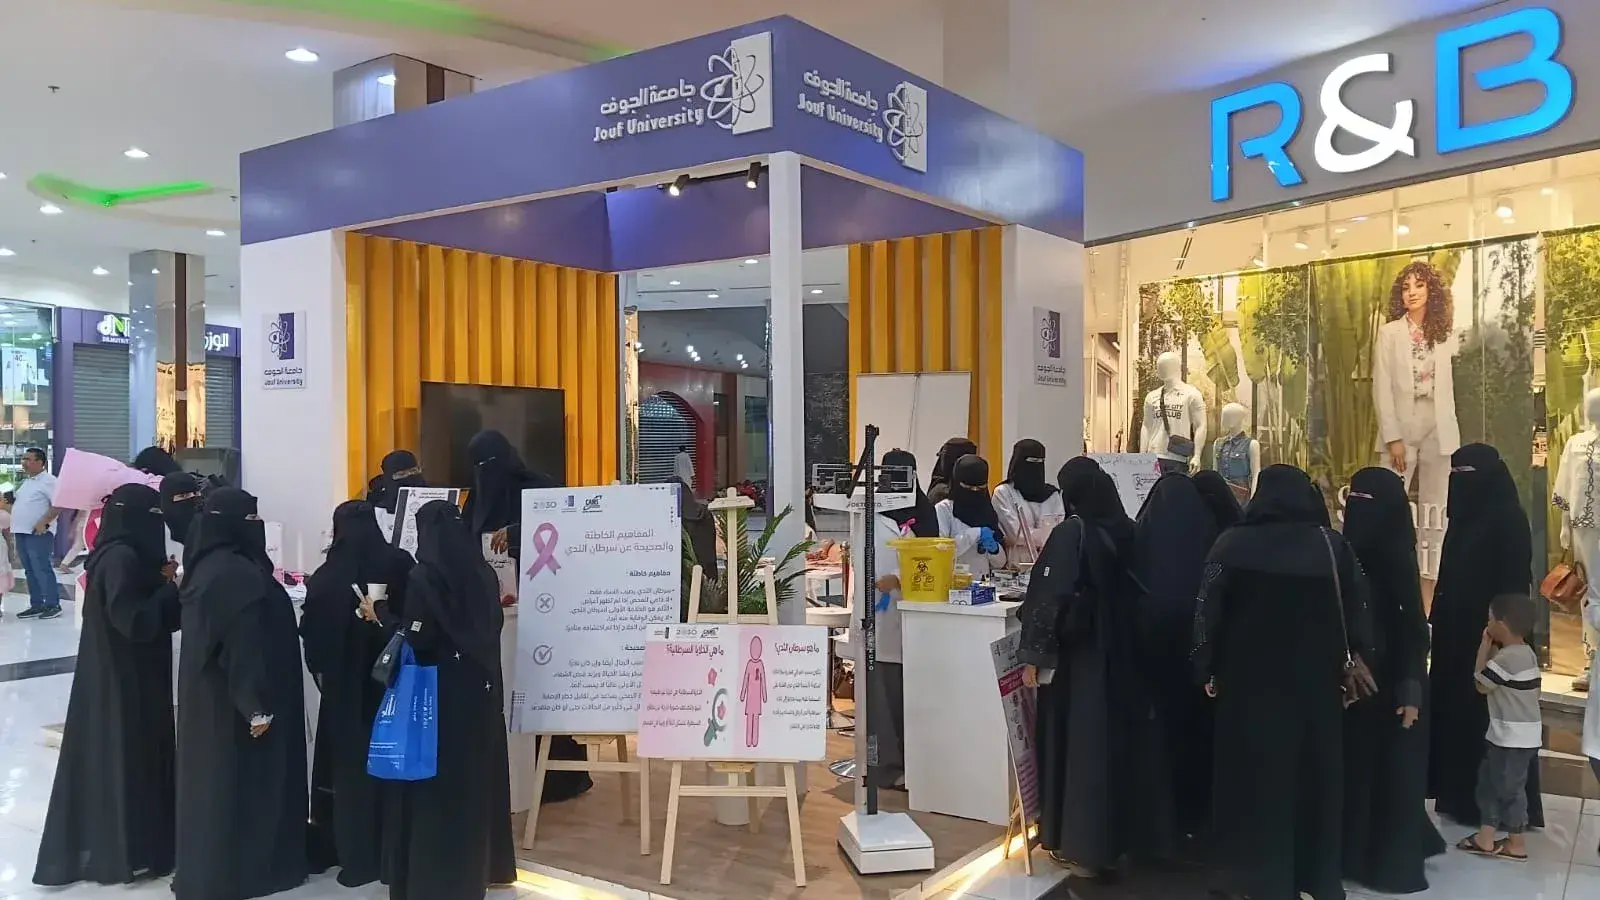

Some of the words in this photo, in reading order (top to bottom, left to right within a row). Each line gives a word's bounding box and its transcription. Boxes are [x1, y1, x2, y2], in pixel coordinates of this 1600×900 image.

[649, 78, 697, 104] جامعة
[803, 70, 846, 100] الجوف
[600, 87, 650, 115] الجوف
[842, 81, 879, 117] جامعة
[1210, 6, 1575, 203] R&B
[593, 121, 625, 142] Jouf
[626, 104, 705, 135] University
[797, 93, 826, 118] Jouf
[826, 103, 884, 143] University
[584, 529, 615, 540] الخاطئة
[616, 528, 654, 540] المفاهيم
[564, 543, 588, 557] الثدي
[589, 543, 618, 555] سرطان
[619, 543, 632, 553] عن
[633, 541, 674, 553] والصحيحة
[647, 569, 671, 578] مفاهيم
